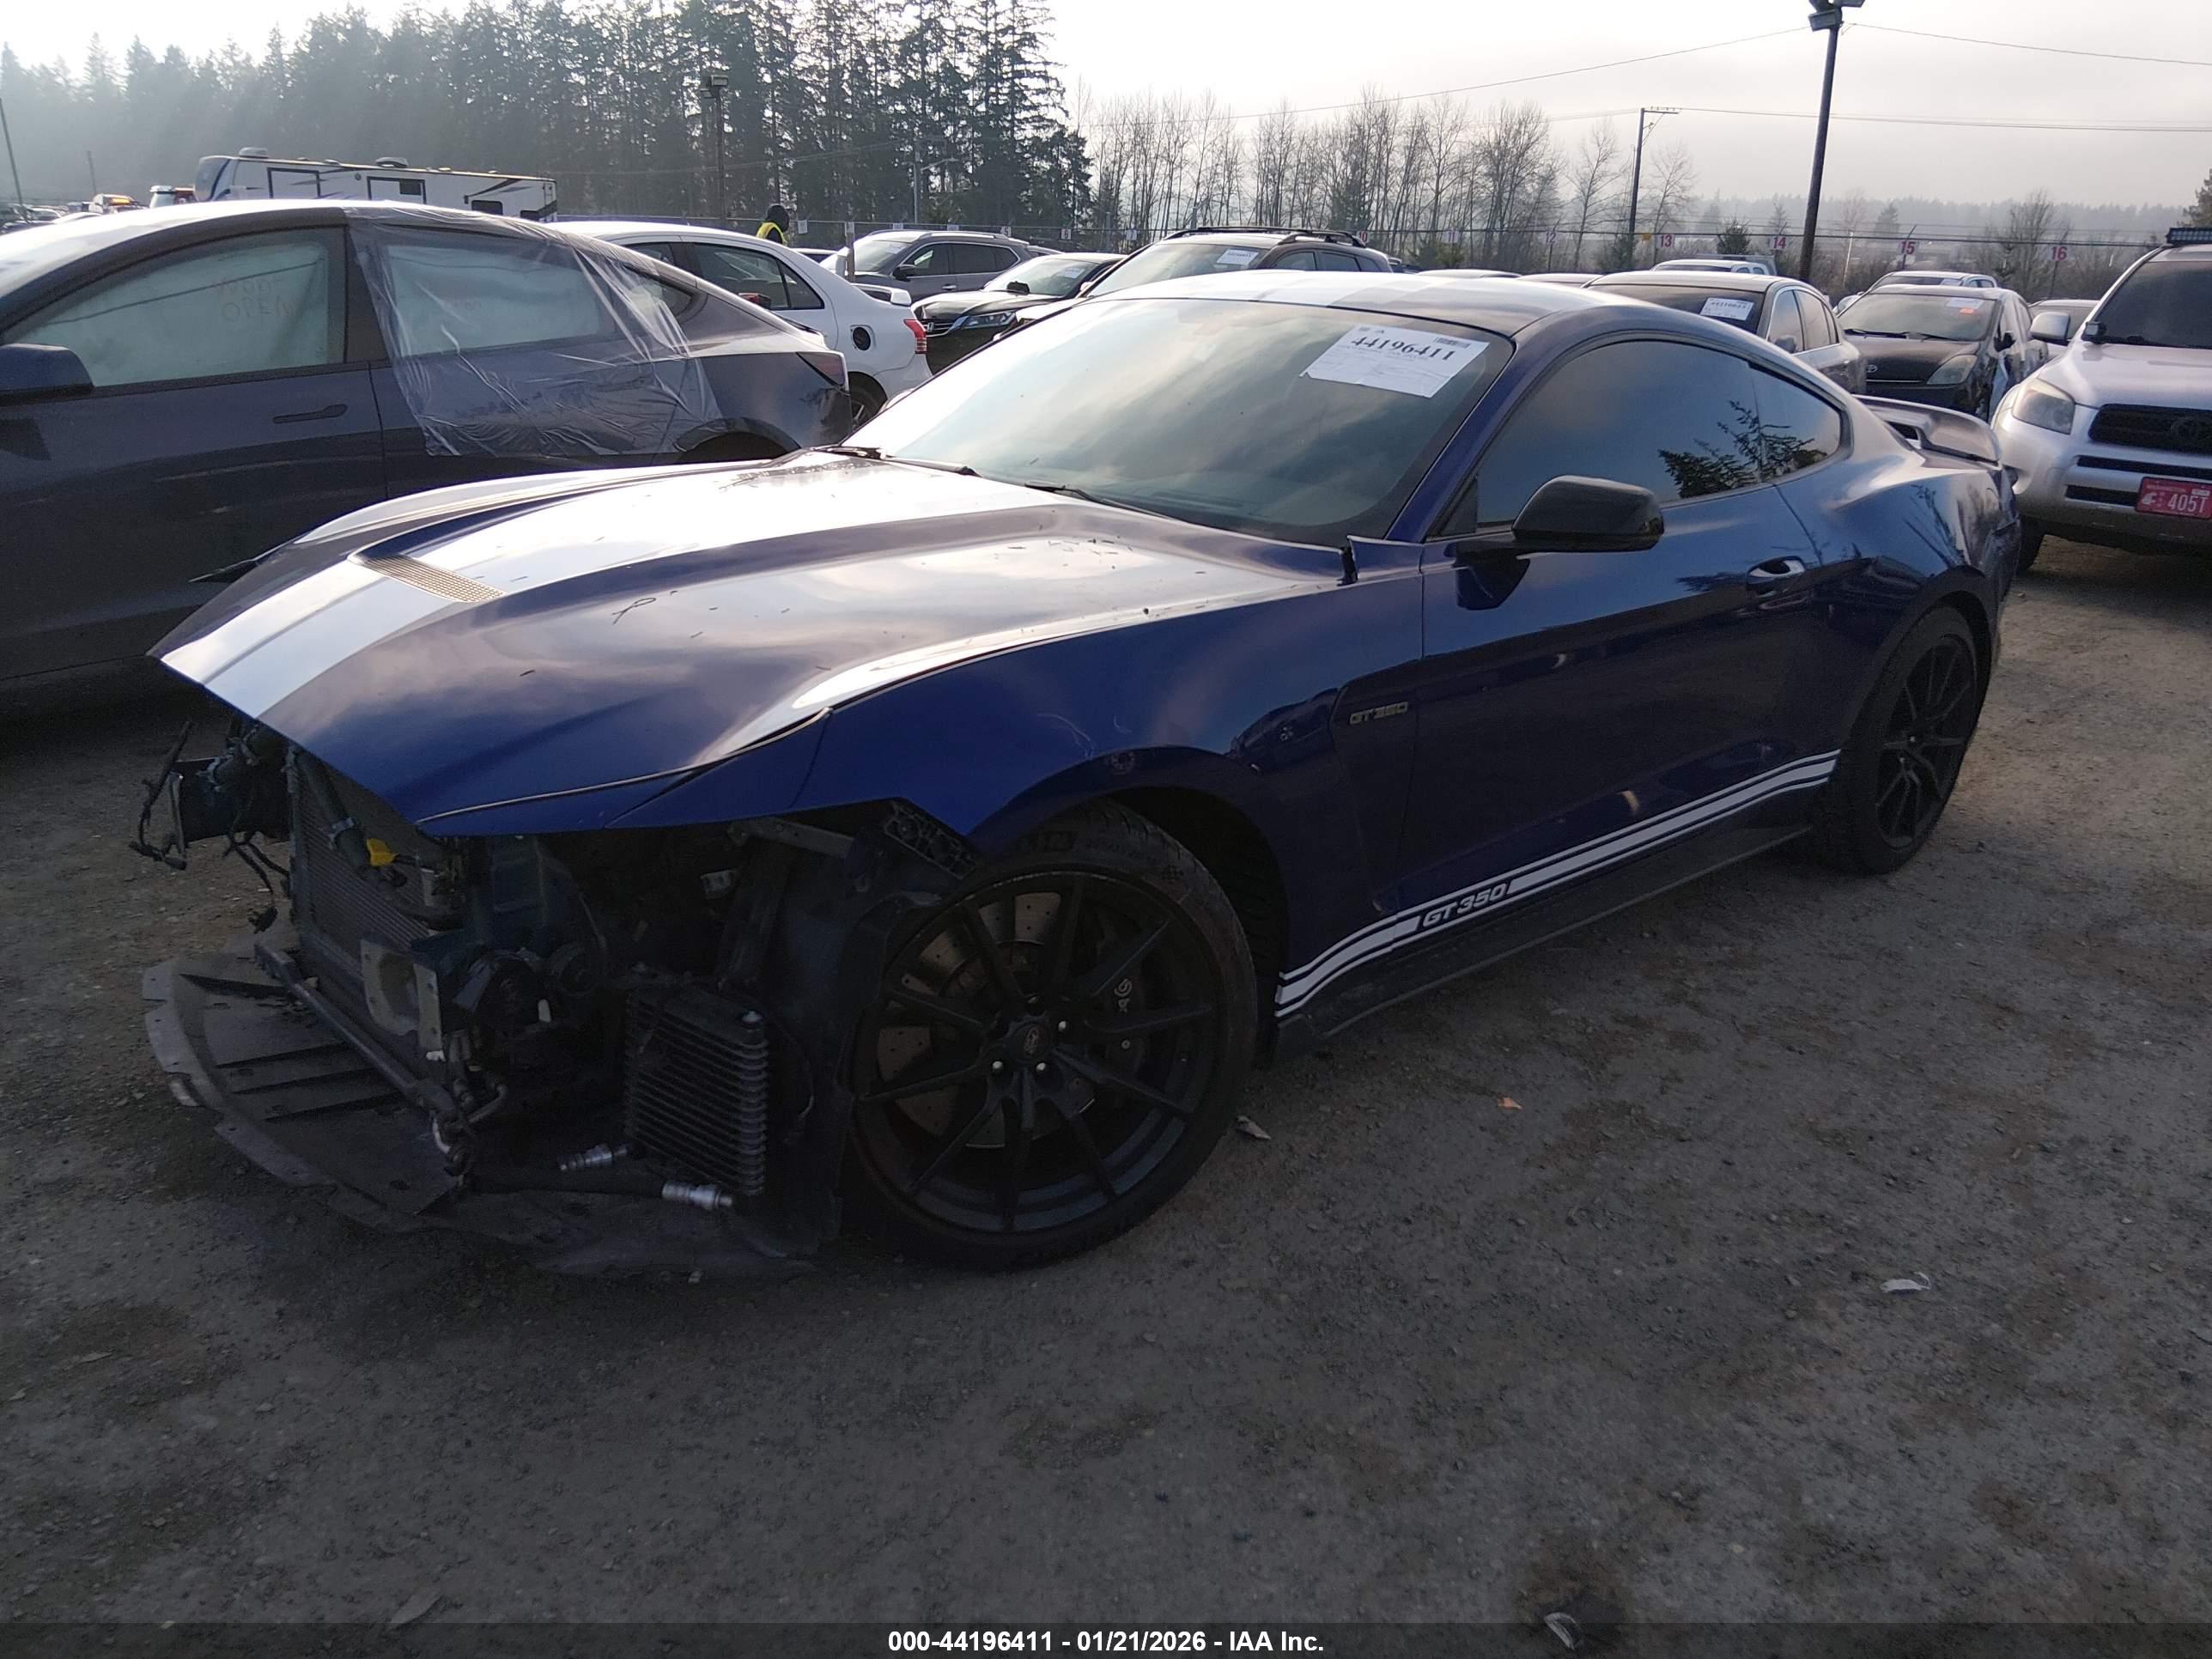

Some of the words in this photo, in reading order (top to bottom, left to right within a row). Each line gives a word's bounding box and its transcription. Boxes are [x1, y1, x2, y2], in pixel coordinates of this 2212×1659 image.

[1546, 233, 1557, 244] 12
[1661, 234, 1672, 247] 13
[1773, 236, 1786, 249] 14
[1900, 240, 1916, 254] 15
[2051, 246, 2068, 261] 16
[1352, 336, 1456, 361] 44196411
[2167, 493, 2209, 514] 405T
[1423, 883, 1507, 927] GT350
